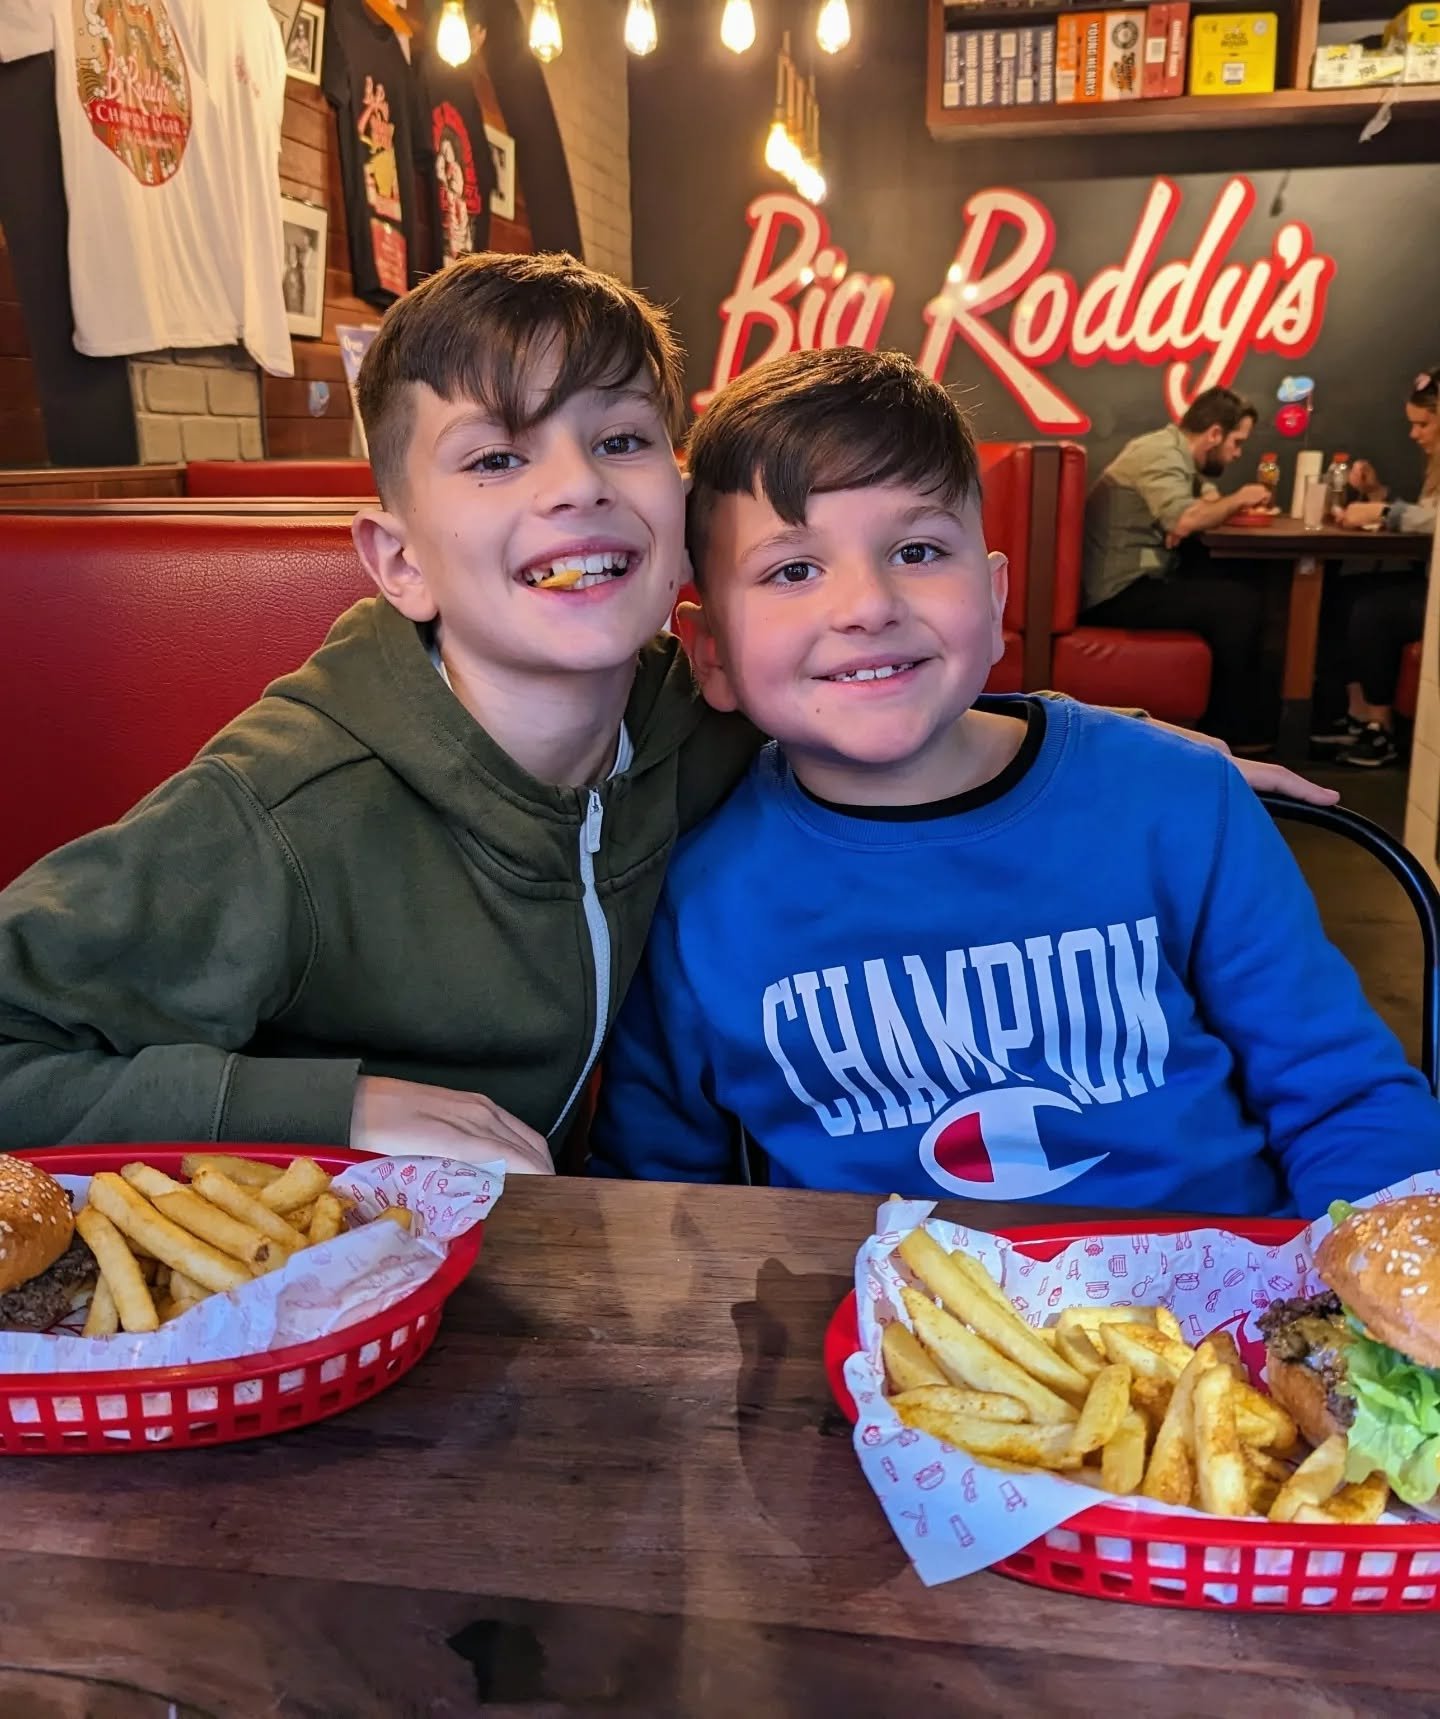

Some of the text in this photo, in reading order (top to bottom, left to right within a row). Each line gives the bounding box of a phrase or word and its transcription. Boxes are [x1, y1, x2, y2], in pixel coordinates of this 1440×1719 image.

[1087, 22, 1099, 56] YOUNG
[693, 175, 1337, 434] Big Roddy's
[762, 916, 1170, 1138] CHAMPION
